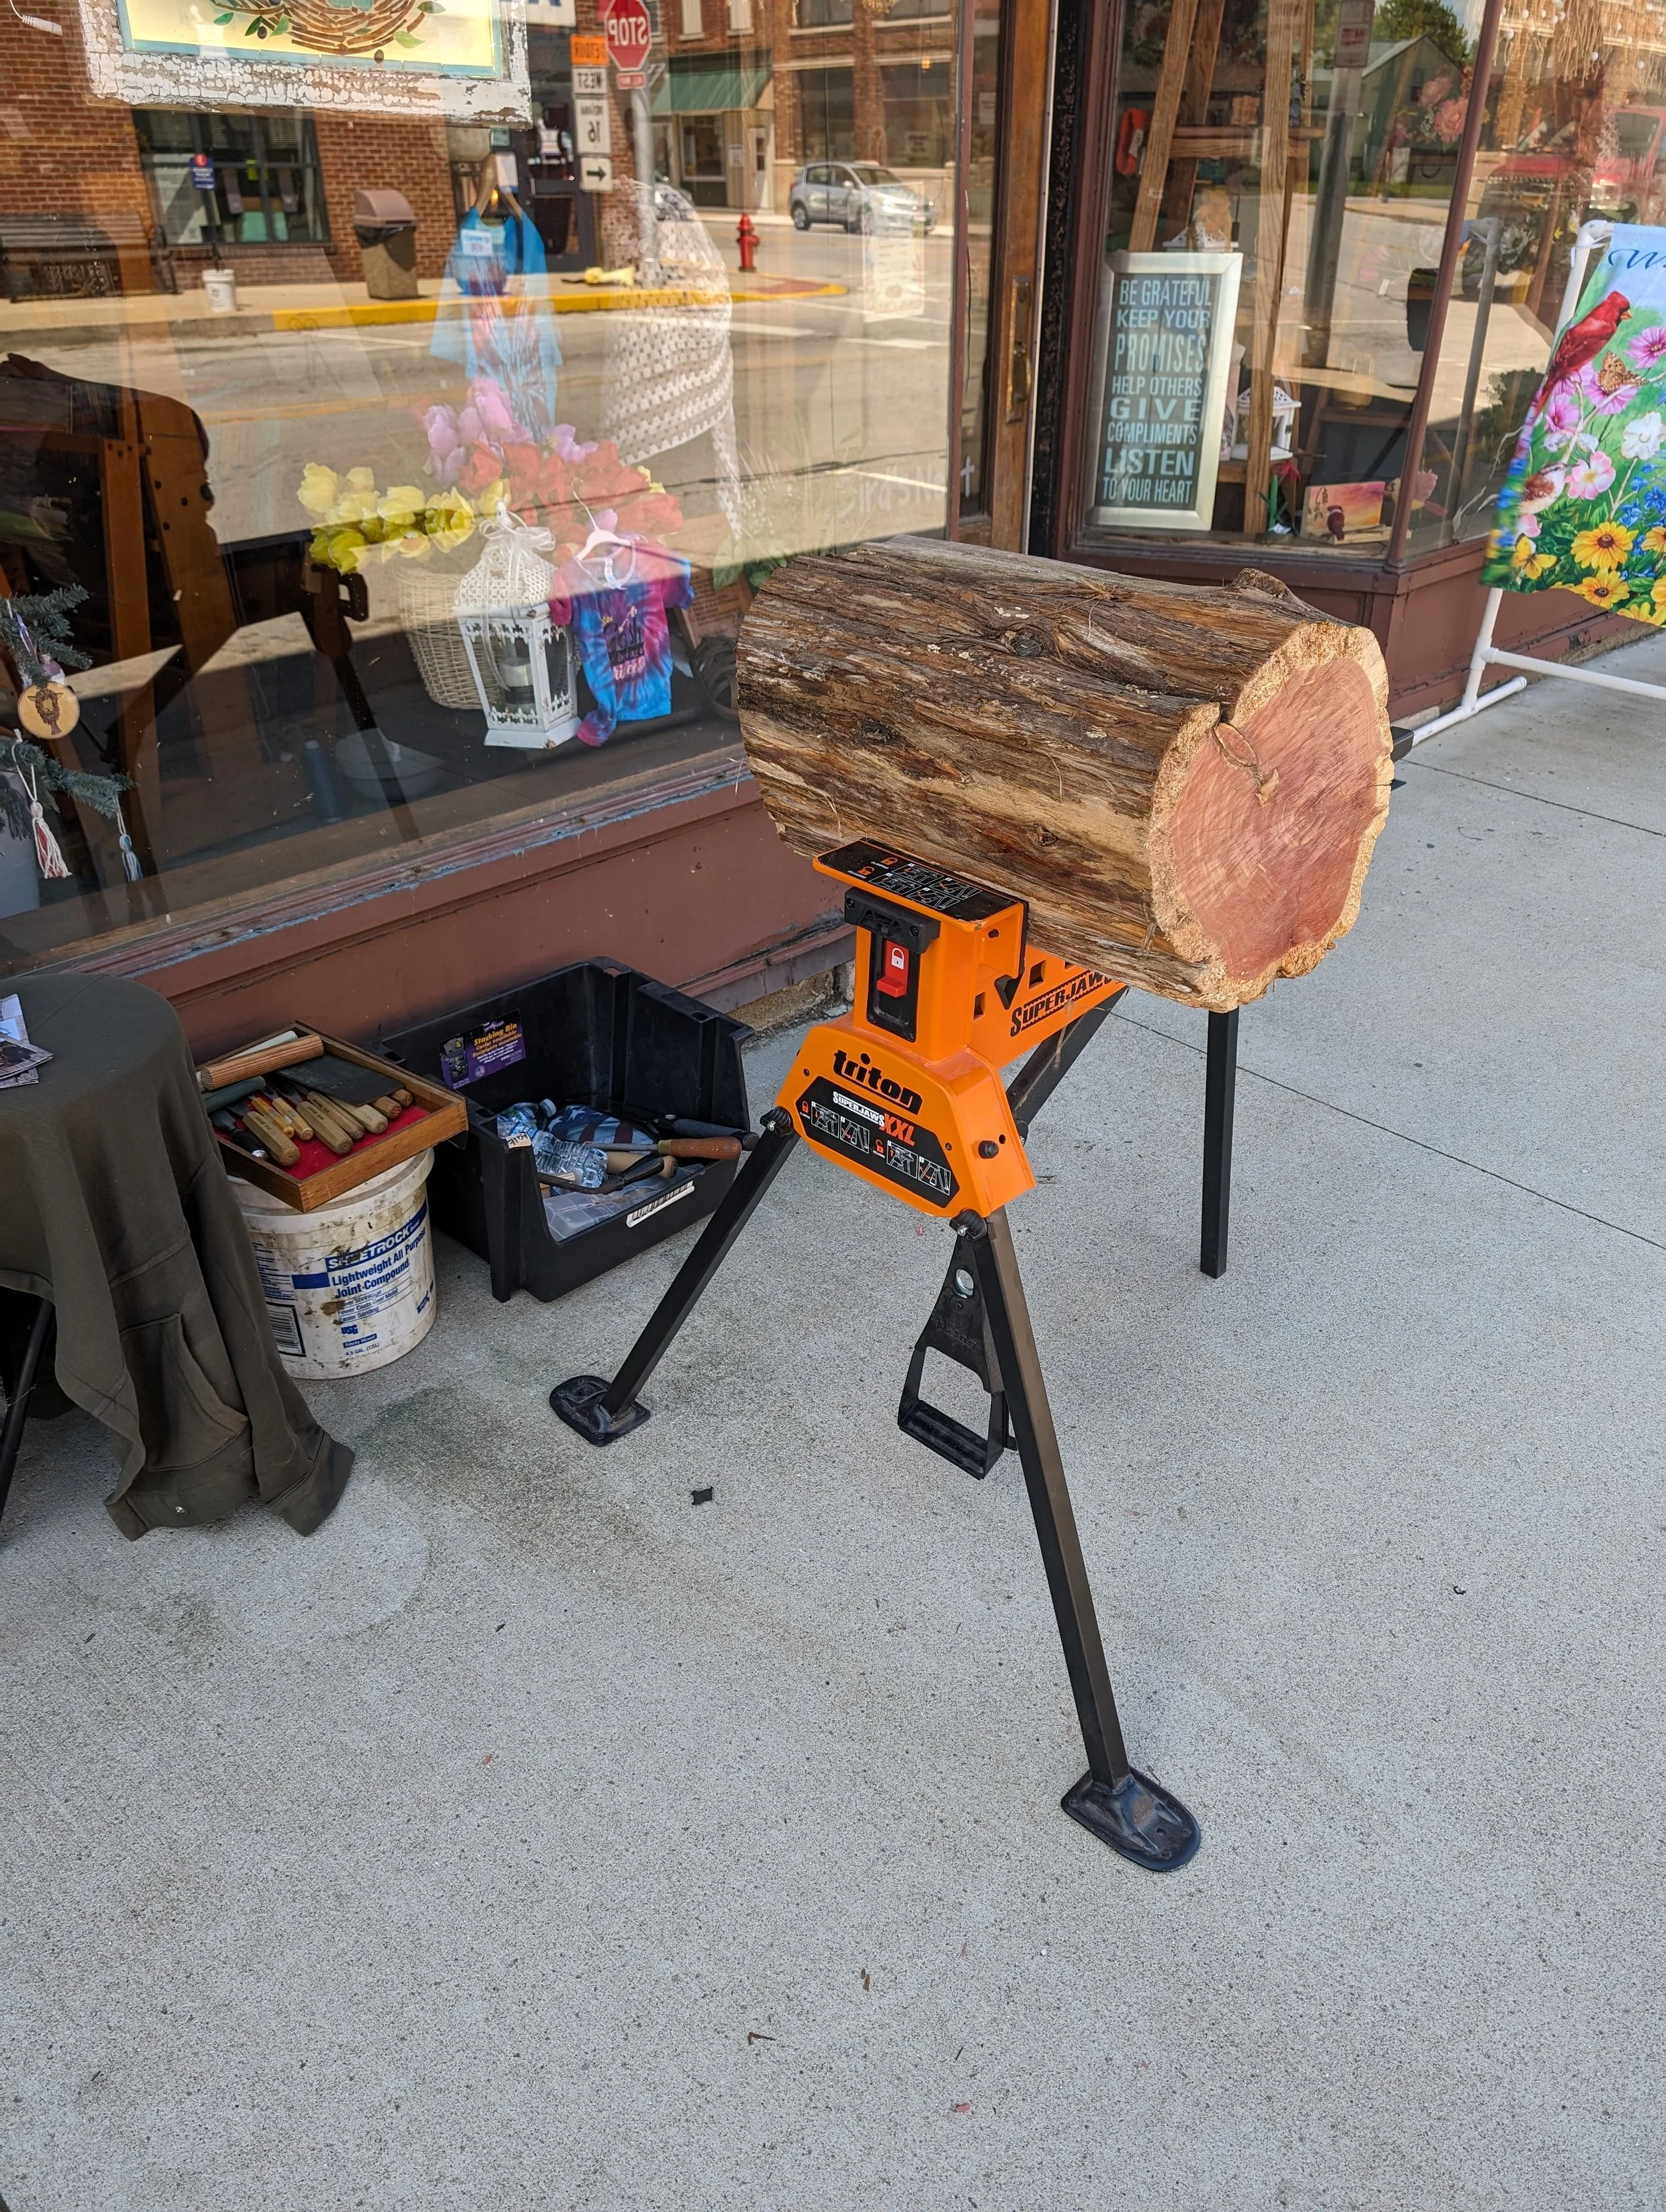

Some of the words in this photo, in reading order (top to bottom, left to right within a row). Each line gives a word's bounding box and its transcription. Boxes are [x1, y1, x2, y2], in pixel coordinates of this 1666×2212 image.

[1120, 280, 1138, 305] BE
[1142, 280, 1212, 306] GRATEFUL
[1116, 309, 1159, 328] KEEP
[1165, 309, 1212, 329] YOUR
[1114, 333, 1207, 373] PROMISES
[1112, 376, 1146, 394] HELP
[1149, 376, 1203, 397] OTHERS
[1110, 396, 1202, 422] GIVE
[1107, 421, 1198, 445] COMPLIMENTS
[1104, 447, 1195, 477] LISTEN
[1103, 476, 1118, 500] TO
[1120, 477, 1152, 501] YOUR
[1154, 479, 1193, 504] HEART
[474, 1029, 504, 1046] Stacking
[505, 1023, 518, 1033] Bin
[833, 1049, 923, 1115] triton
[833, 1091, 885, 1127] SUPERJAWS
[879, 1113, 916, 1146] XXL
[332, 1257, 393, 1287] Lightweight
[393, 1250, 404, 1264] All
[405, 1227, 426, 1255] Purpose
[335, 1283, 362, 1299] Joint
[364, 1257, 410, 1290] Compound
[337, 1307, 355, 1316] Fewer
[356, 1301, 372, 1311] Coats
[385, 1288, 399, 1299] Metal
[357, 1307, 379, 1318] Sanding
[341, 1324, 359, 1335] USG
[345, 1339, 361, 1348] Ready
[361, 1334, 376, 1343] Mixed
